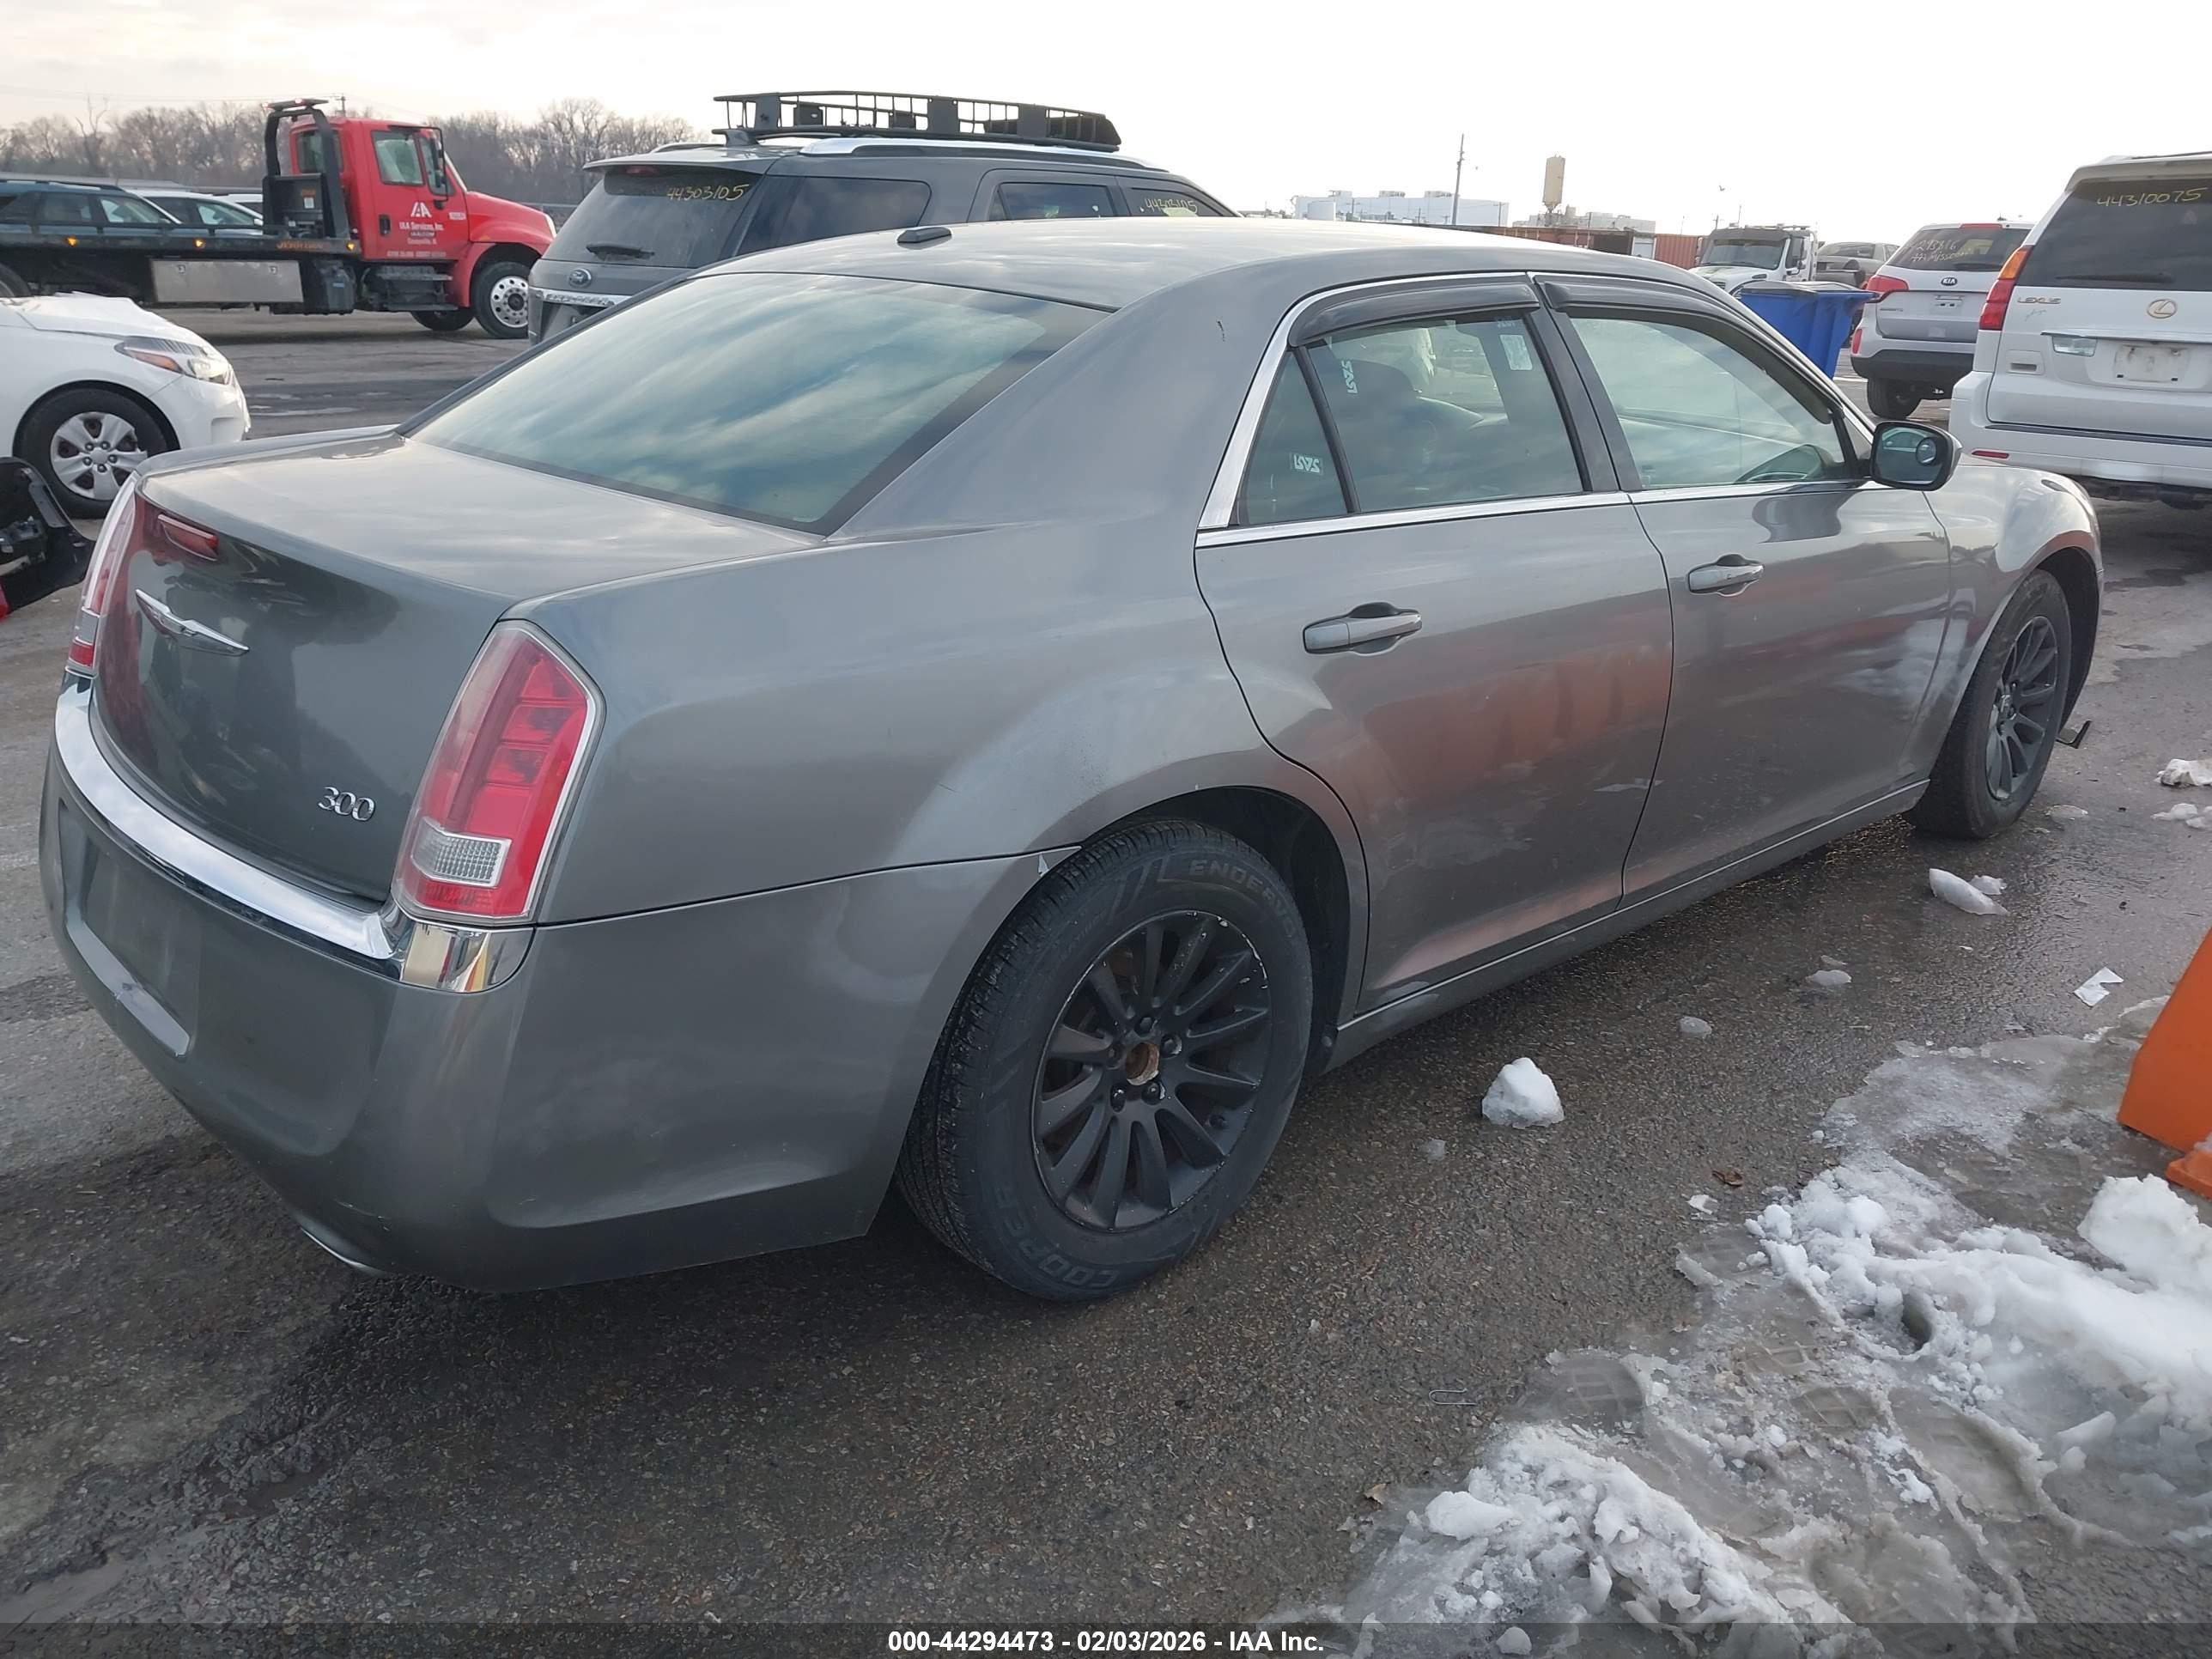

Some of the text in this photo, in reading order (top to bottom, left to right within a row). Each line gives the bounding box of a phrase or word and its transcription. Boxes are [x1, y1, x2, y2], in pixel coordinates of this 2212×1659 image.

[666, 184, 750, 201] 44303105
[2097, 187, 2208, 206] 44310075
[410, 201, 432, 217] IAA
[318, 786, 375, 822] 300
